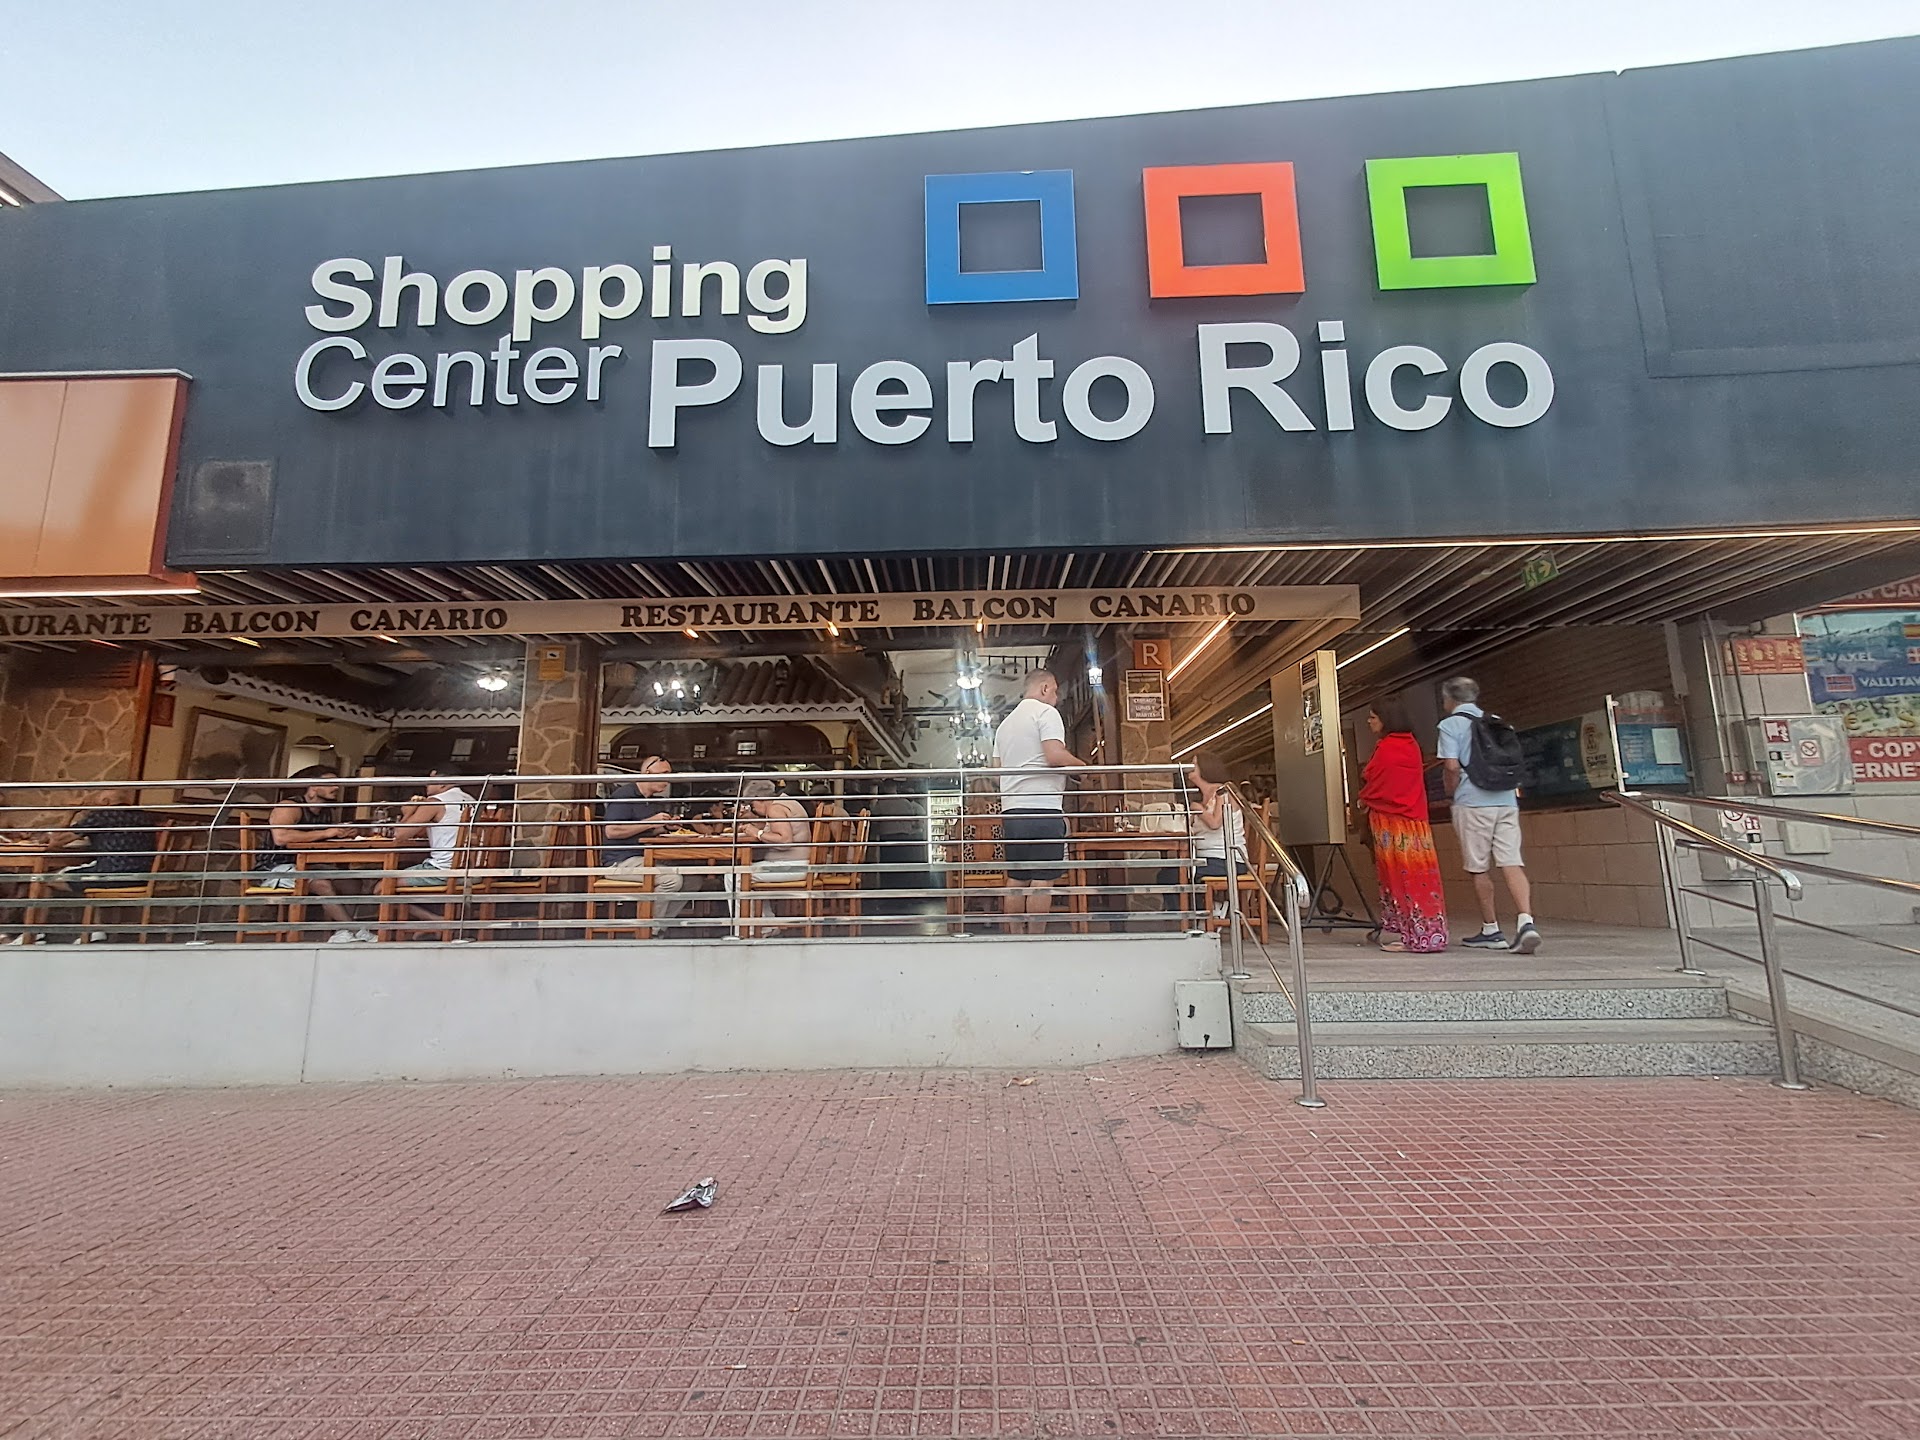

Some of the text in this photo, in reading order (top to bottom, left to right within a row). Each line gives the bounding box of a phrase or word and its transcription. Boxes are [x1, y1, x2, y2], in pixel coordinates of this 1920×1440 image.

[305, 245, 807, 341] Shopping
[295, 320, 1555, 448] Center Puerto Rico
[181, 610, 320, 634] BALCON
[350, 607, 508, 632] CANARIO
[620, 593, 1255, 628] RESTAURANTE BALCON CANARIO
[1142, 642, 1163, 666] R
